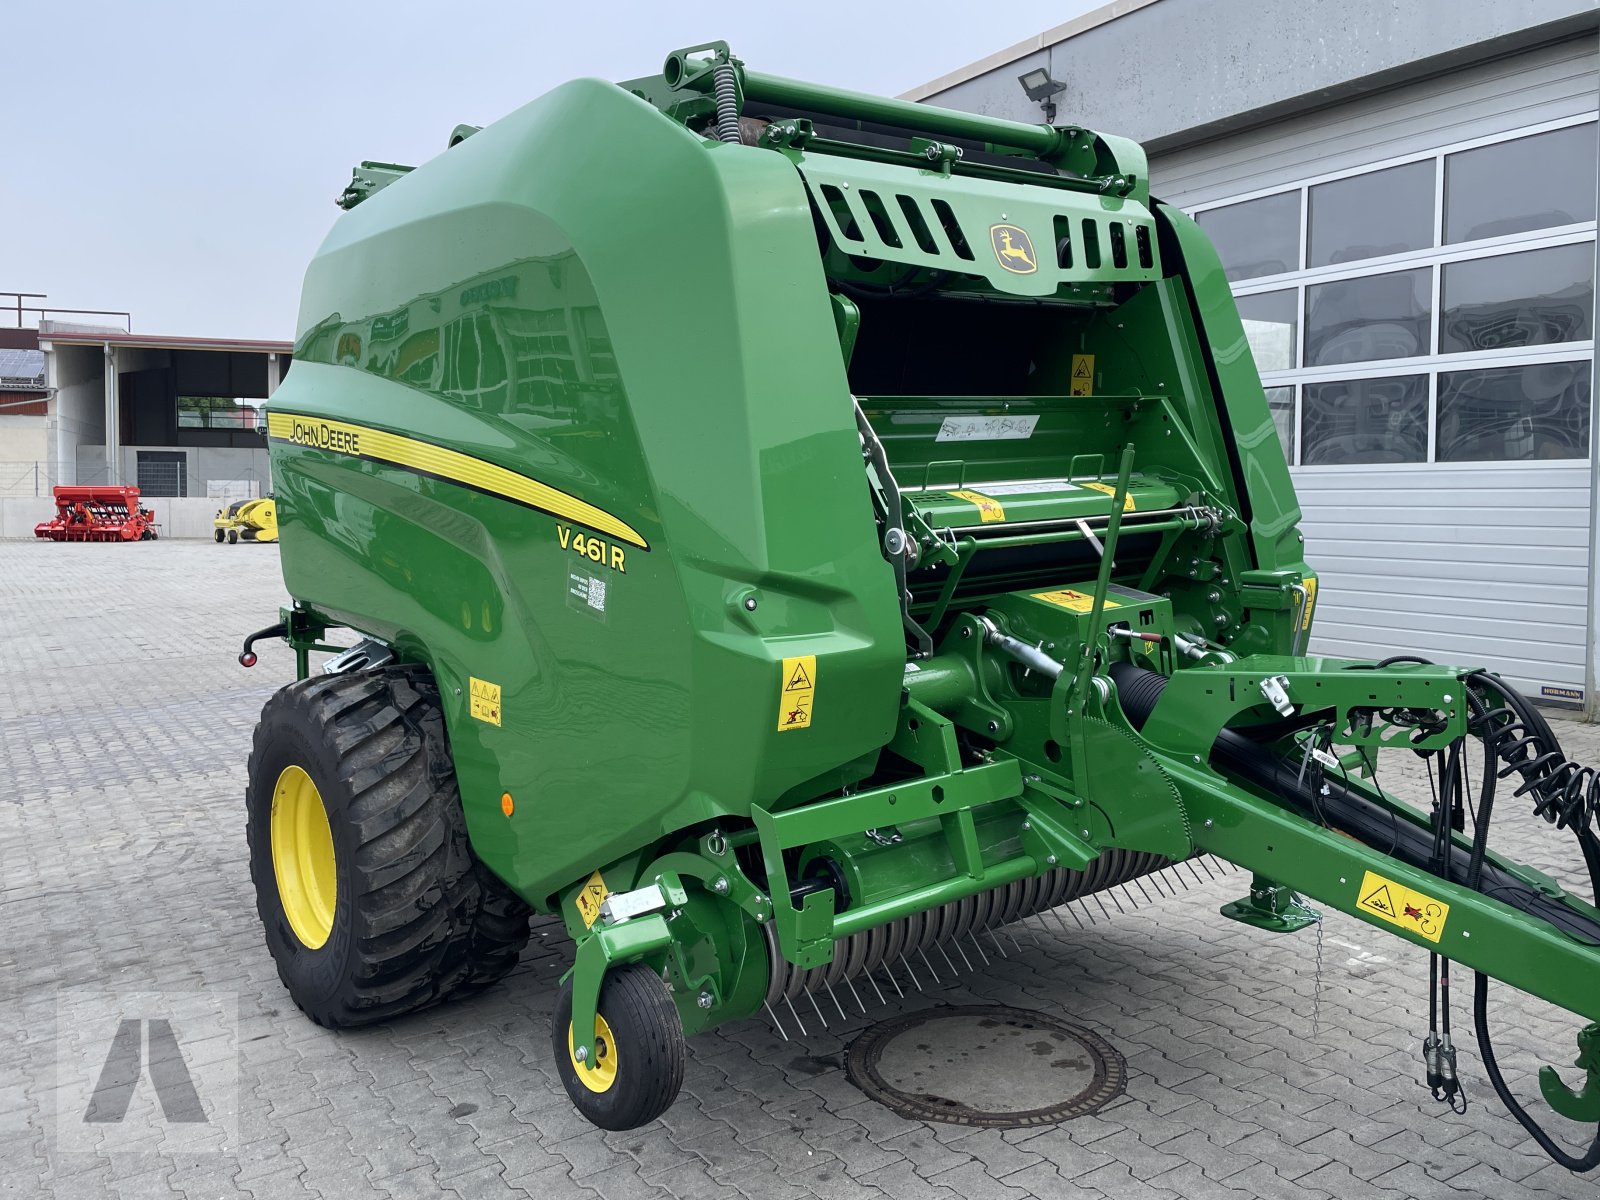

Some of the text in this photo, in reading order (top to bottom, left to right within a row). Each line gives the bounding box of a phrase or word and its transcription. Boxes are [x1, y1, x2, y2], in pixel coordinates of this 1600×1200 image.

[289, 419, 360, 452] JOHN DEERE
[556, 523, 627, 574] V 461 R
